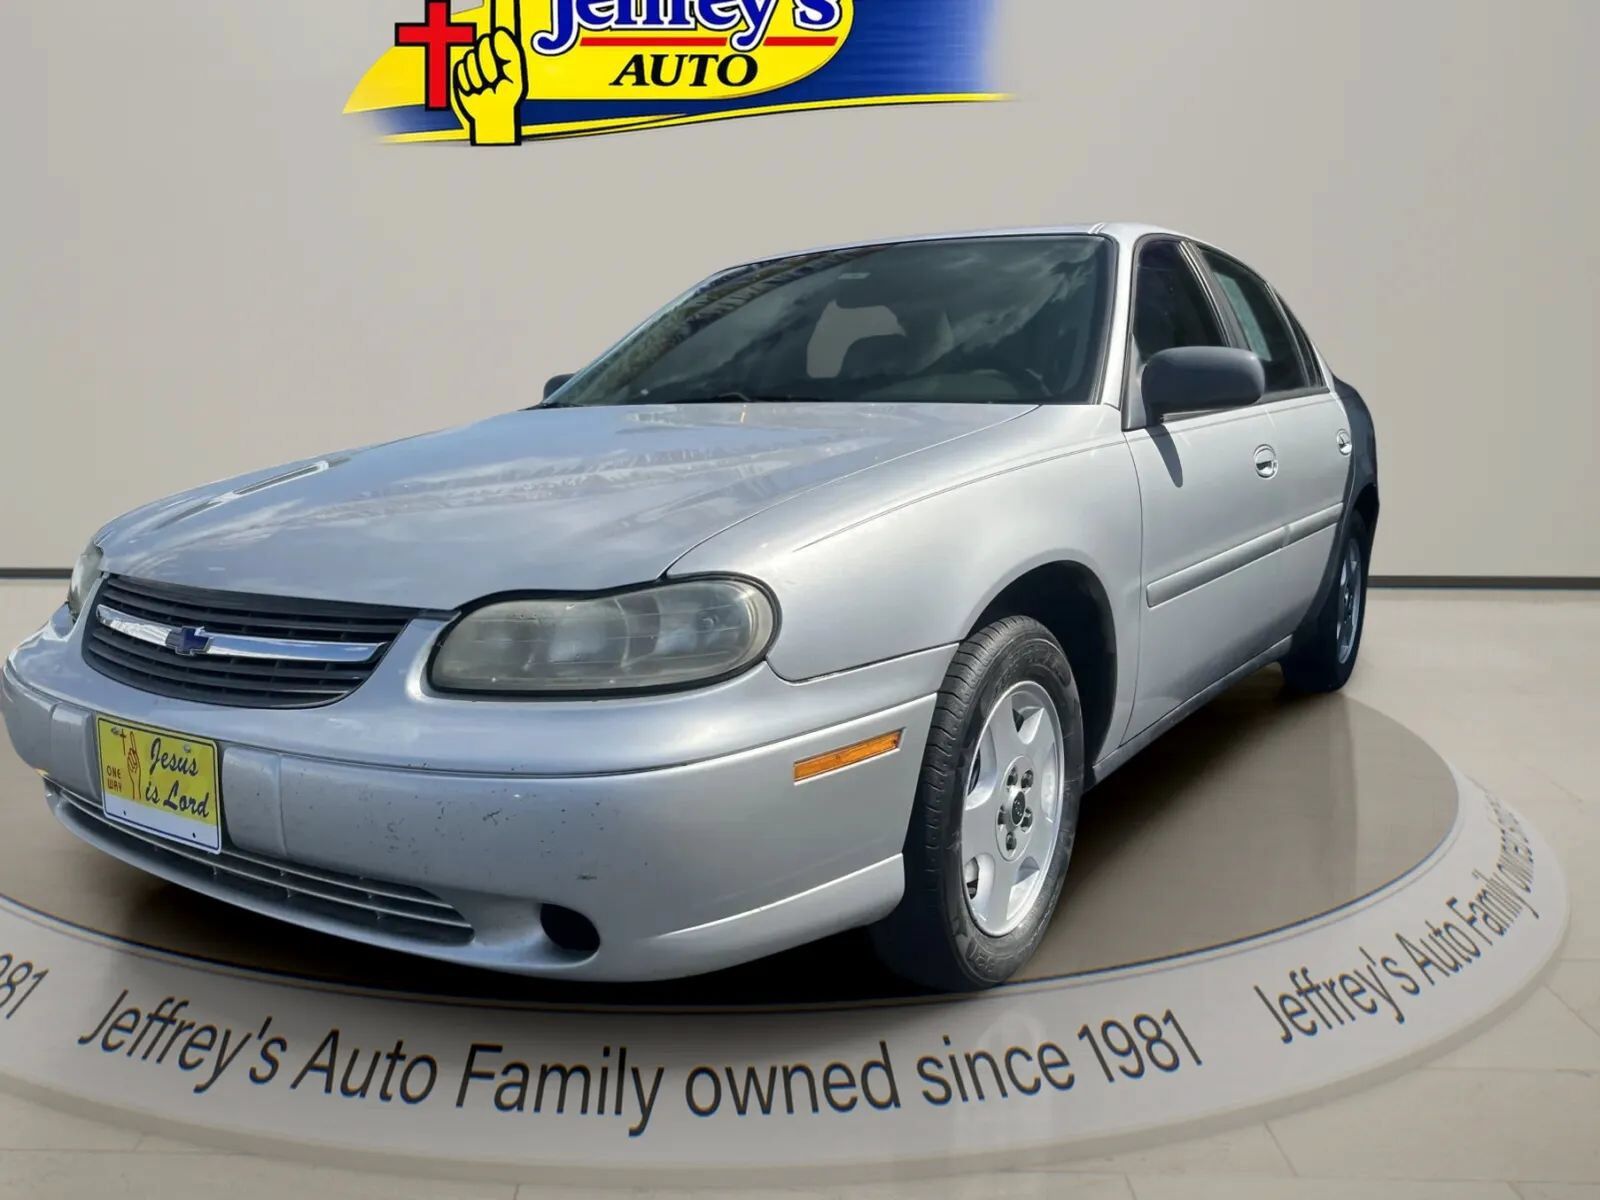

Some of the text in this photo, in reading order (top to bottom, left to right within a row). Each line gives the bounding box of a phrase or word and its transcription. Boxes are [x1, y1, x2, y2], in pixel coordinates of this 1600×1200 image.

[609, 53, 758, 87] AUTO
[106, 764, 121, 779] ONE
[149, 737, 199, 777] Jesus
[107, 779, 122, 793] WAY
[145, 780, 209, 818] is Lord
[1253, 946, 1421, 1044] Jeffrey's
[1395, 919, 1482, 986] Auto
[77, 989, 1203, 1137] Jeffrey's Auto Family owned since 1981
